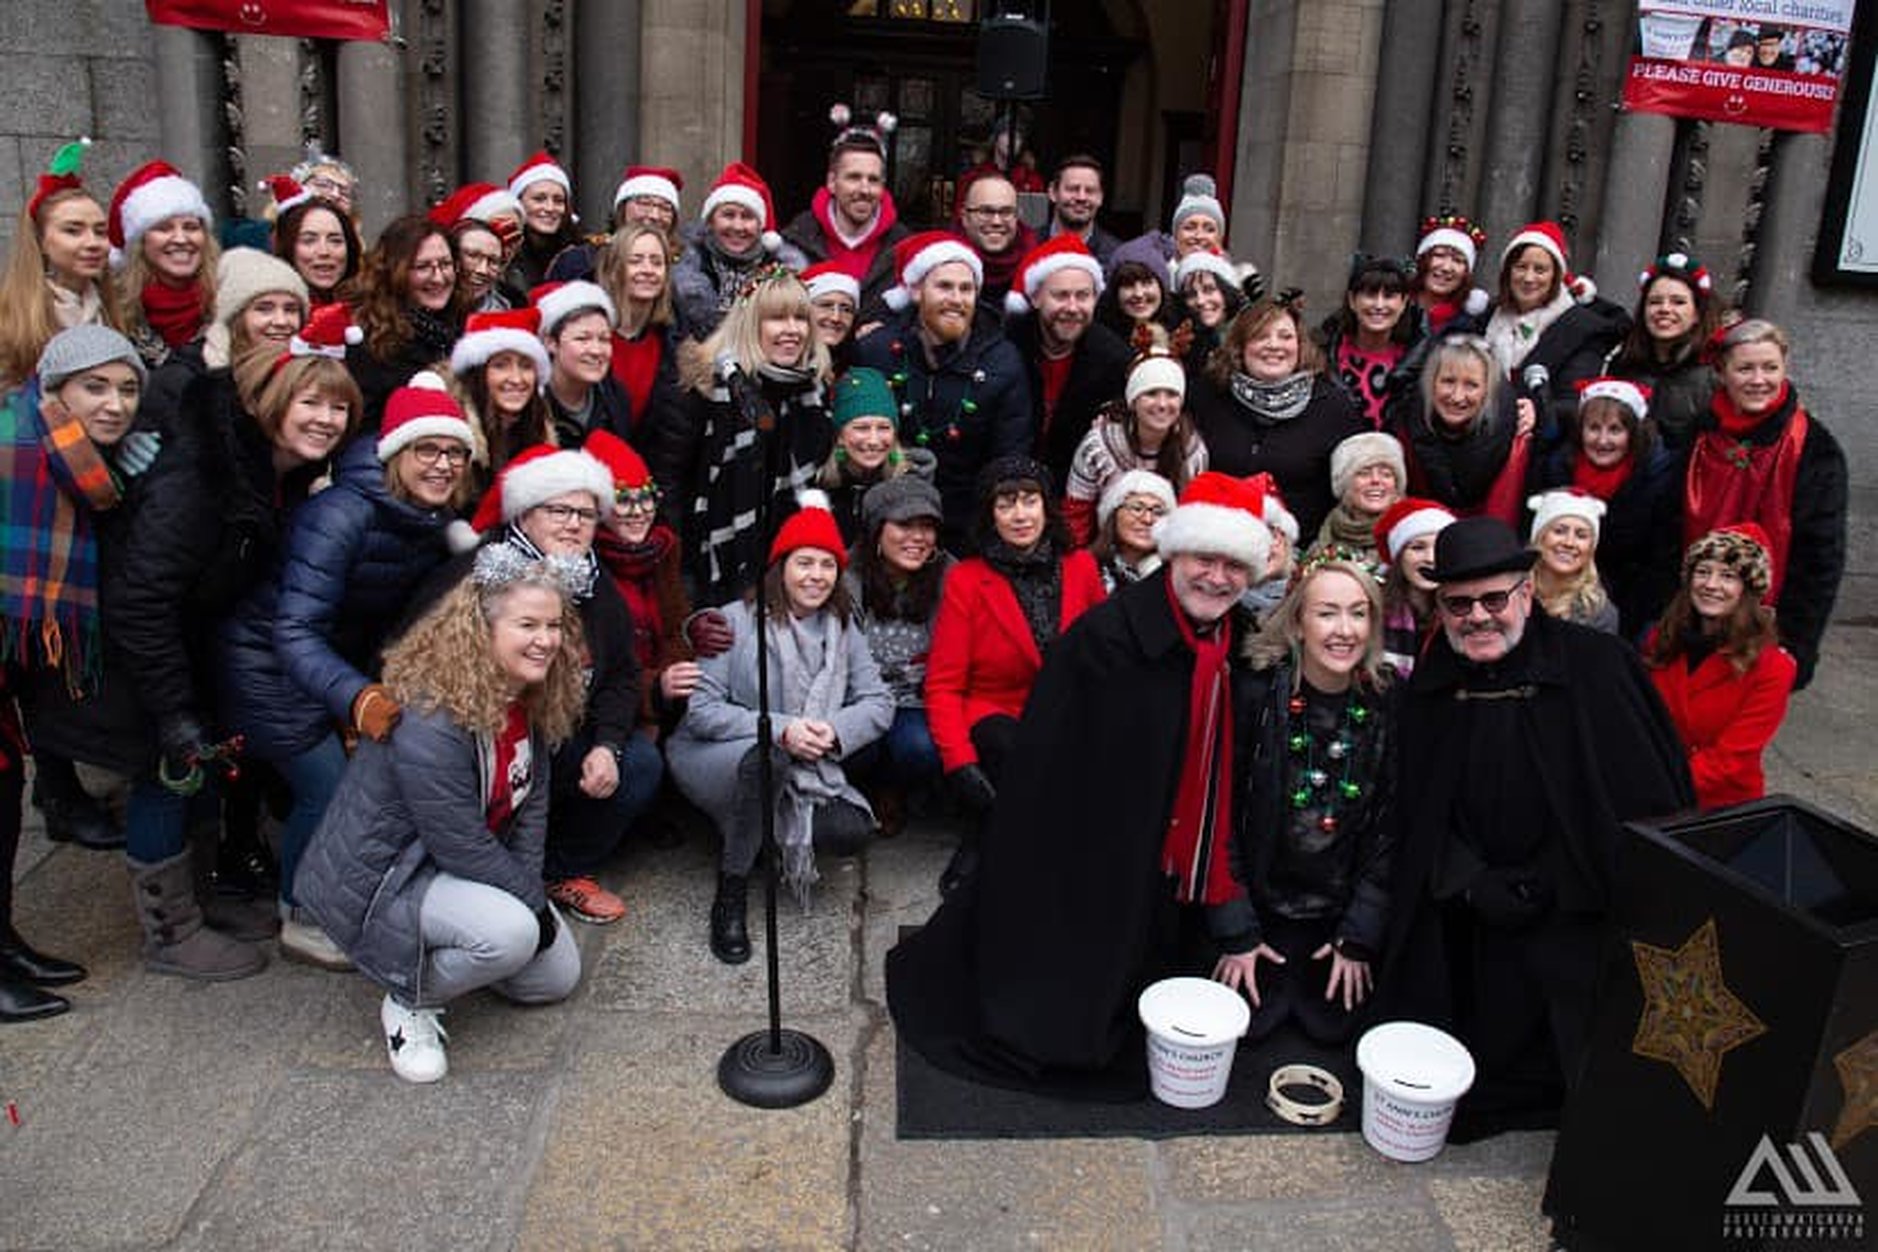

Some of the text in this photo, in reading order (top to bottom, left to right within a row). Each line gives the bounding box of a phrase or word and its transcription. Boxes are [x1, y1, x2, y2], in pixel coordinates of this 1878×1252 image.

[1739, 0, 1777, 14] local
[1781, 3, 1844, 25] charities
[1633, 64, 1700, 85] PLEASE
[1703, 69, 1741, 90] GIVE
